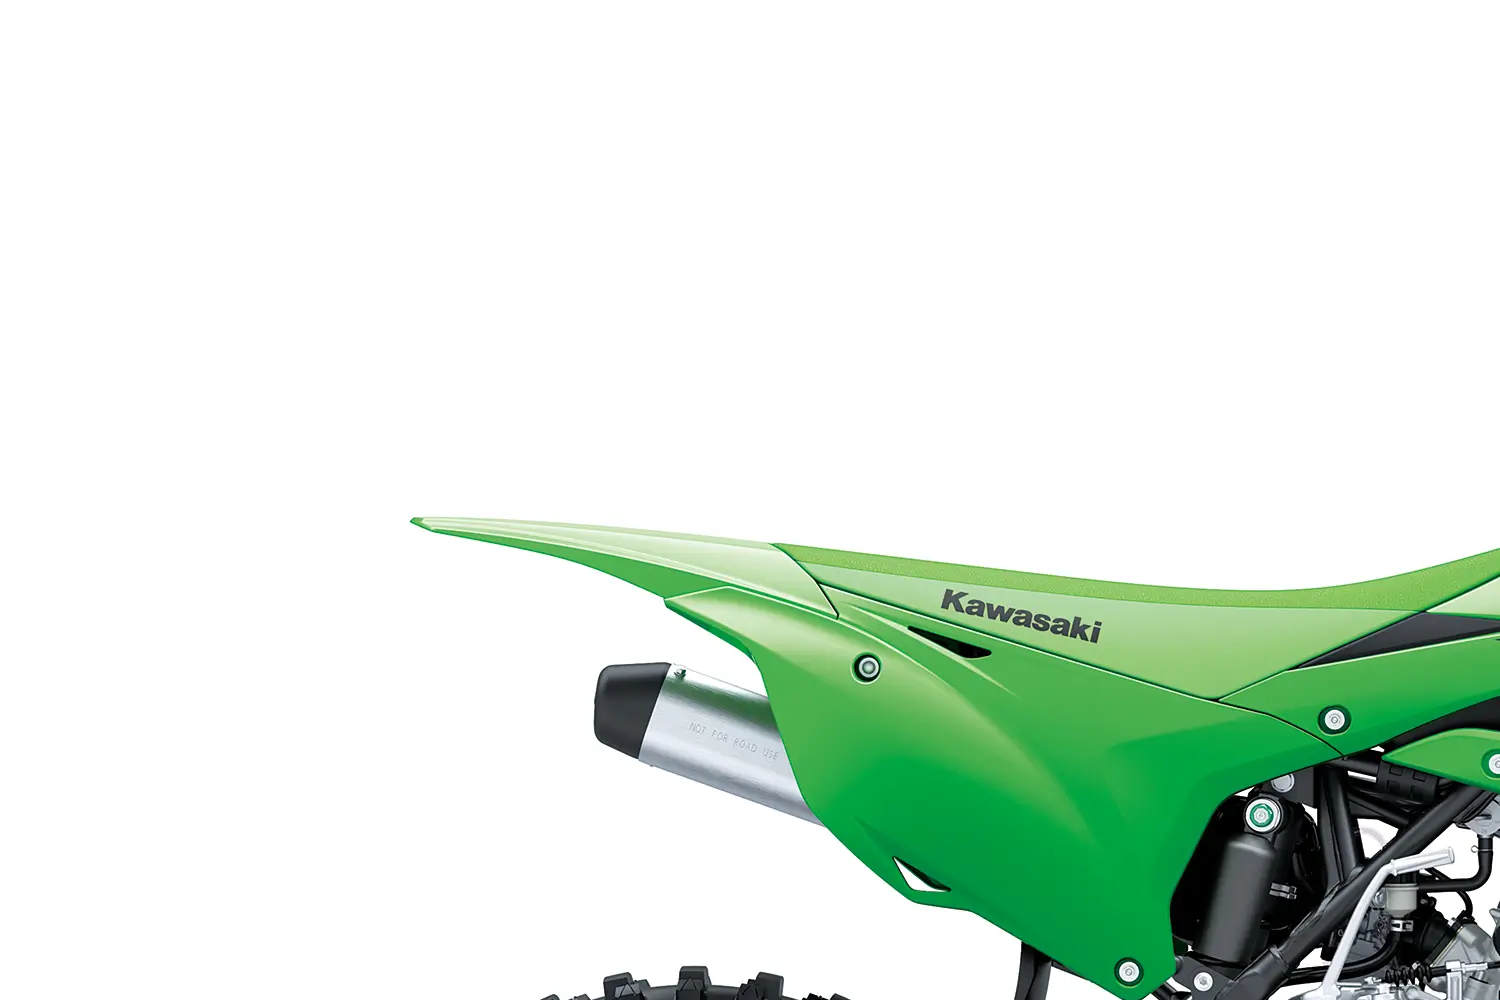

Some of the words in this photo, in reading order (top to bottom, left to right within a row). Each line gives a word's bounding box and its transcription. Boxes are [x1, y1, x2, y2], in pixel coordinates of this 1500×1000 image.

[940, 588, 1103, 644] Kawasaki
[688, 721, 707, 735] NOT
[711, 729, 728, 743] FOR
[733, 736, 758, 754] ROAD
[762, 747, 780, 761] USE
